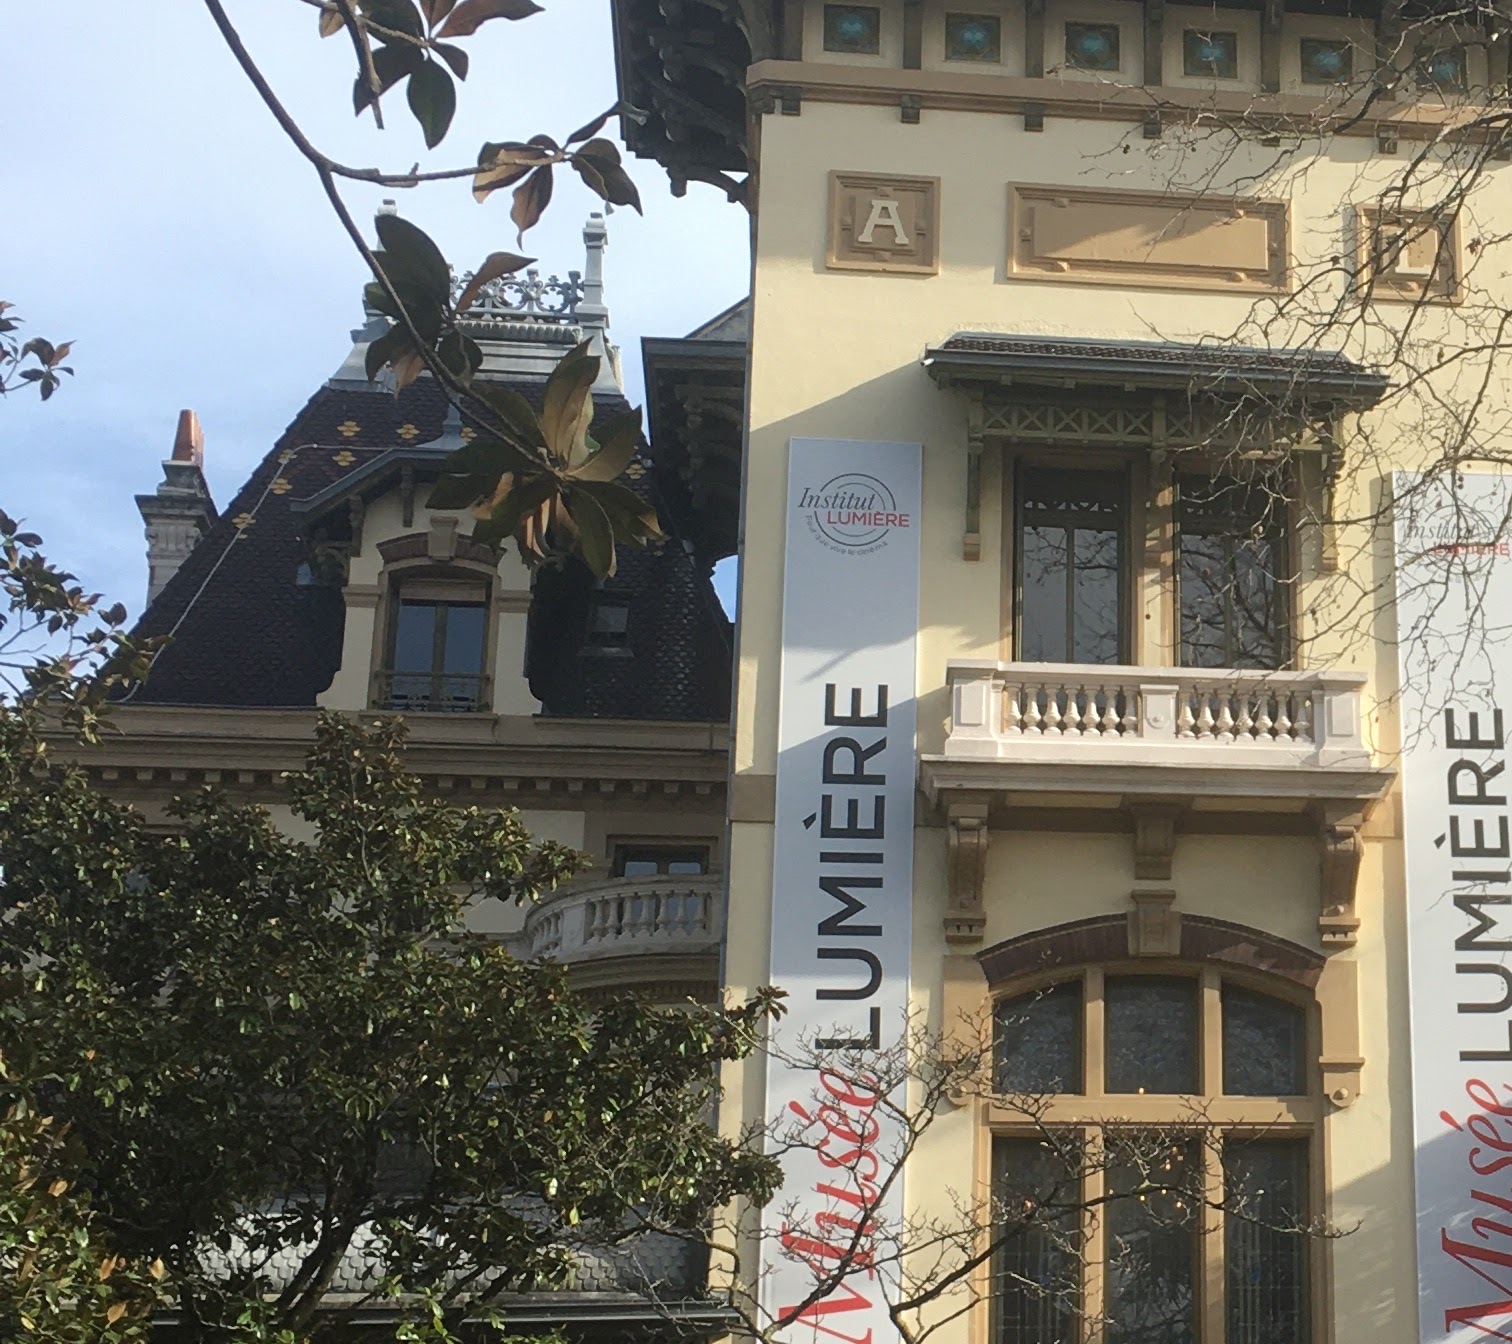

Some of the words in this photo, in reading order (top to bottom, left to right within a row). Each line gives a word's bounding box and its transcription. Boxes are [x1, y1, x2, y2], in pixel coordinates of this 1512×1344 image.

[857, 199, 909, 245] A
[798, 487, 876, 511] Institut
[827, 510, 910, 528] LUMIÈRE
[803, 681, 890, 1053] LUMIÈRE
